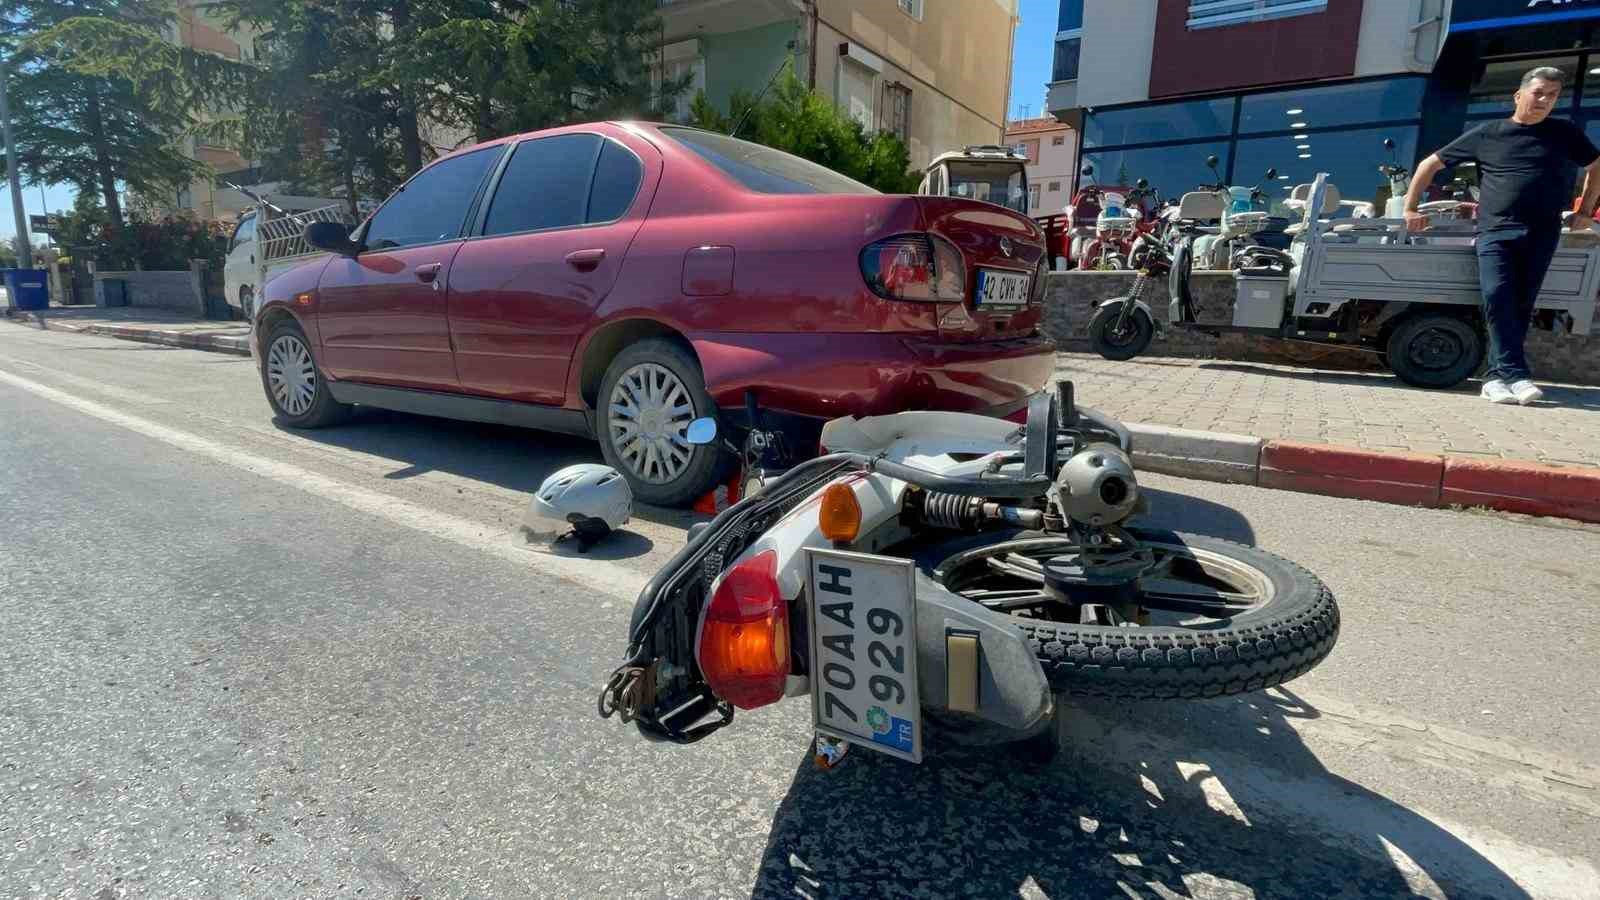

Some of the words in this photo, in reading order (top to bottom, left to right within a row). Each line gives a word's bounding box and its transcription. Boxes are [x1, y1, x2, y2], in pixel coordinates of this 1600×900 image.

[984, 276, 995, 299] 42
[866, 607, 904, 704] 929
[899, 723, 912, 743] TR
